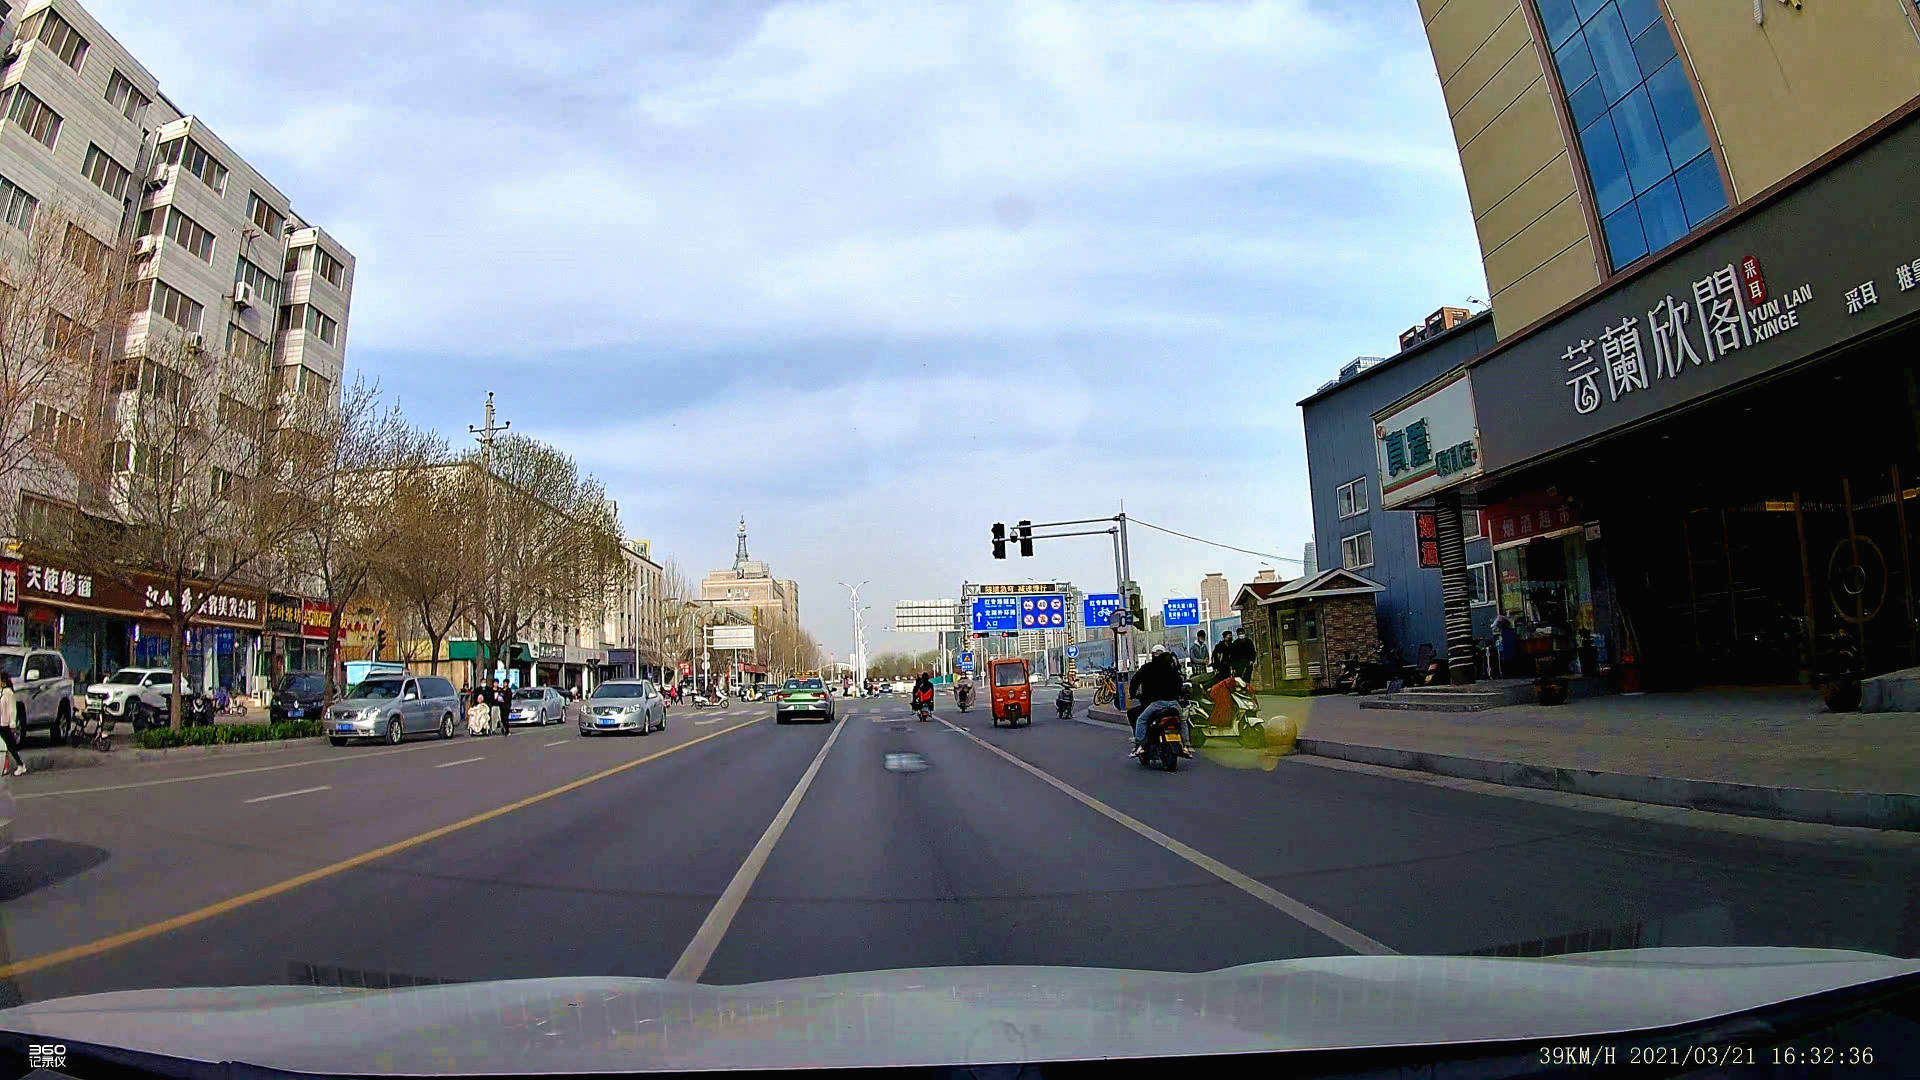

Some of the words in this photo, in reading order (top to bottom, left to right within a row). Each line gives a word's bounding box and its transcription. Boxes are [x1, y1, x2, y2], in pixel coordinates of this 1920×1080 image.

[1743, 259, 1763, 298] 采耳
[1845, 280, 1878, 314] 采耳
[1747, 299, 1780, 325] YUN
[1784, 284, 1813, 309] LAN
[1753, 310, 1799, 343] XINGE
[0, 567, 16, 604] 酒
